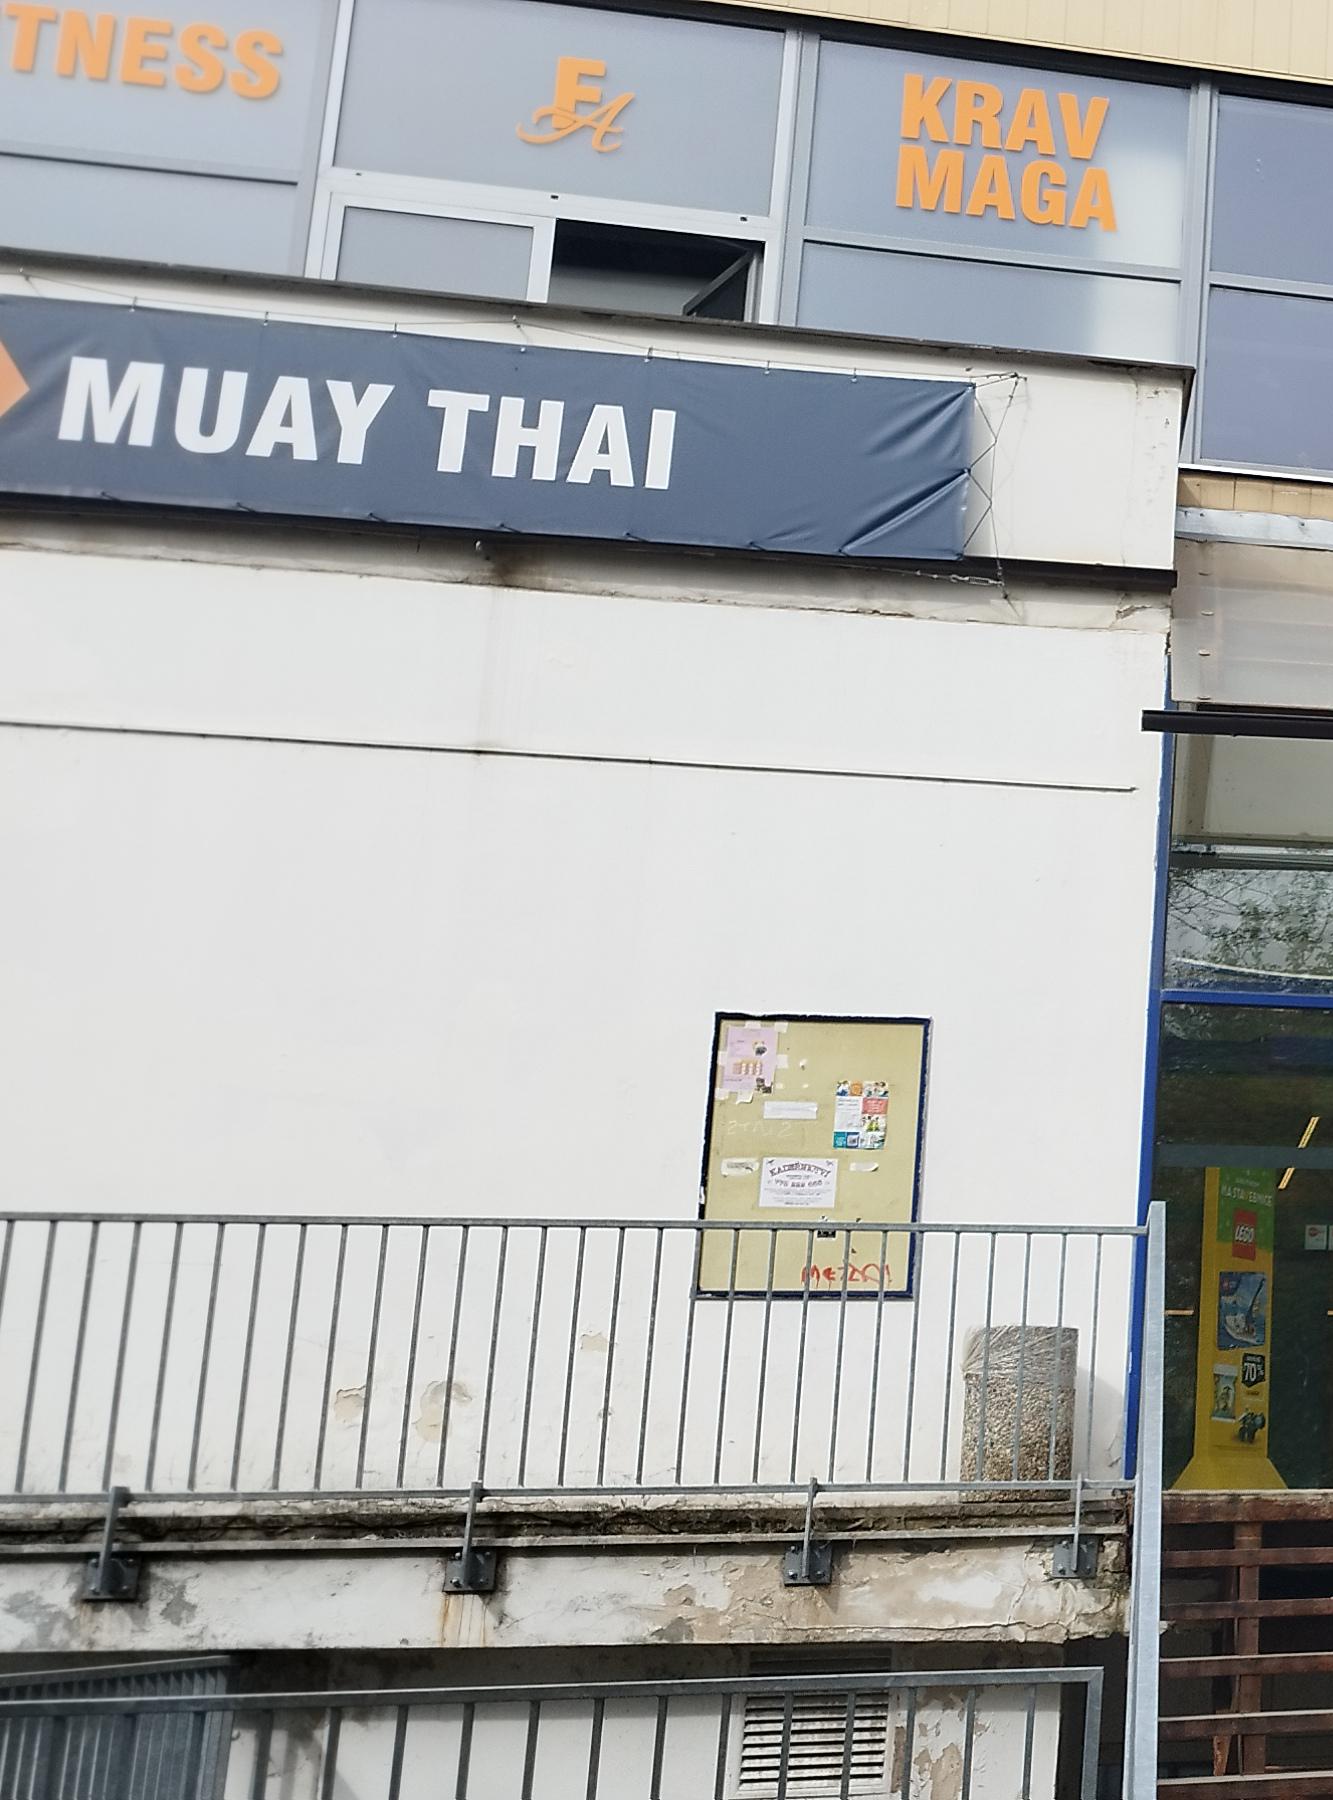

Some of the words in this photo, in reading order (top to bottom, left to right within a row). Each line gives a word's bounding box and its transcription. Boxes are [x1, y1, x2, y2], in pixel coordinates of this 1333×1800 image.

[0, 3, 284, 100] TNESS
[900, 73, 1111, 161] KRAV
[895, 145, 1119, 233] MAGA
[58, 356, 395, 464] MUAY
[427, 389, 678, 490] THAI
